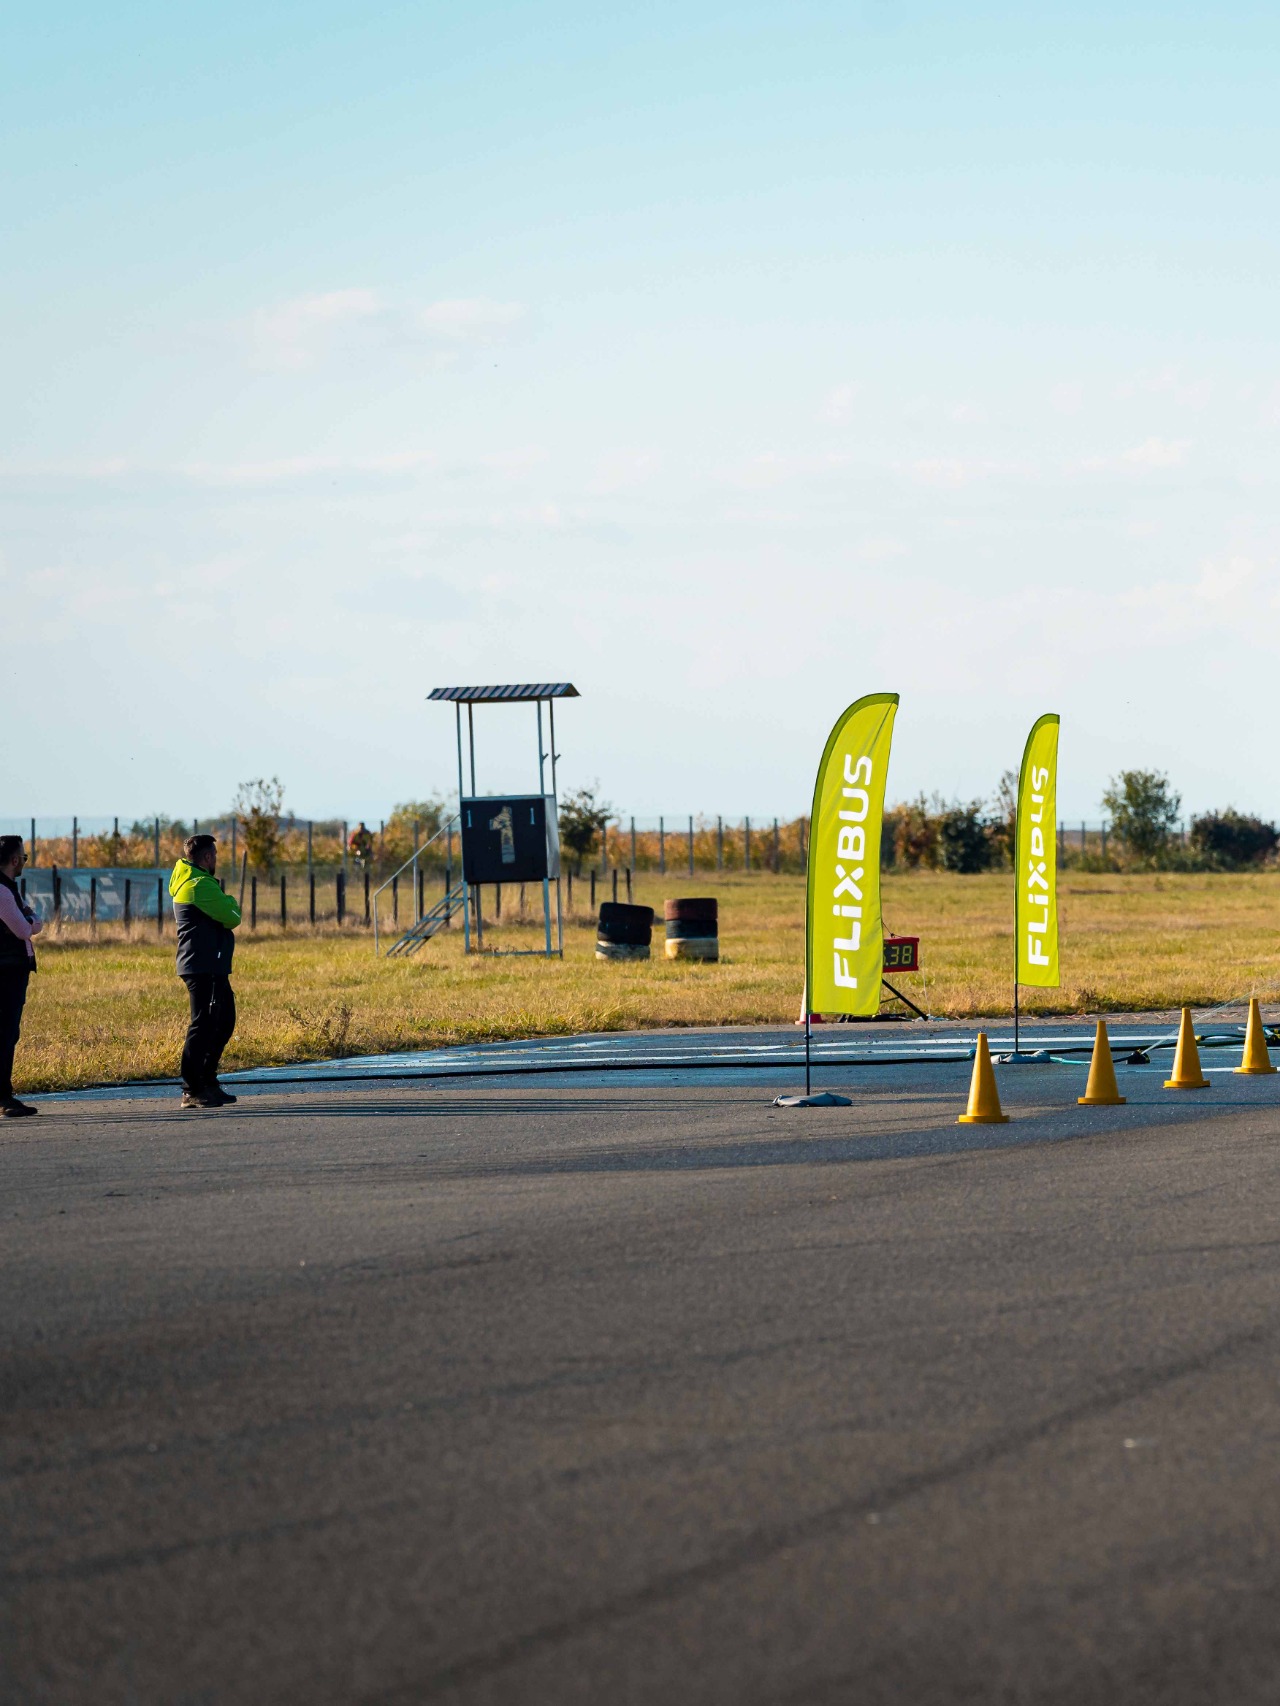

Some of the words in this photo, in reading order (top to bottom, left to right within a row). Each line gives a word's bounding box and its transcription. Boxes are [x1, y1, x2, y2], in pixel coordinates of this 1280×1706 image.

[466, 809, 473, 828] 1
[489, 805, 515, 864] 1
[530, 807, 536, 825] 1
[832, 753, 873, 989] FLiXBUS
